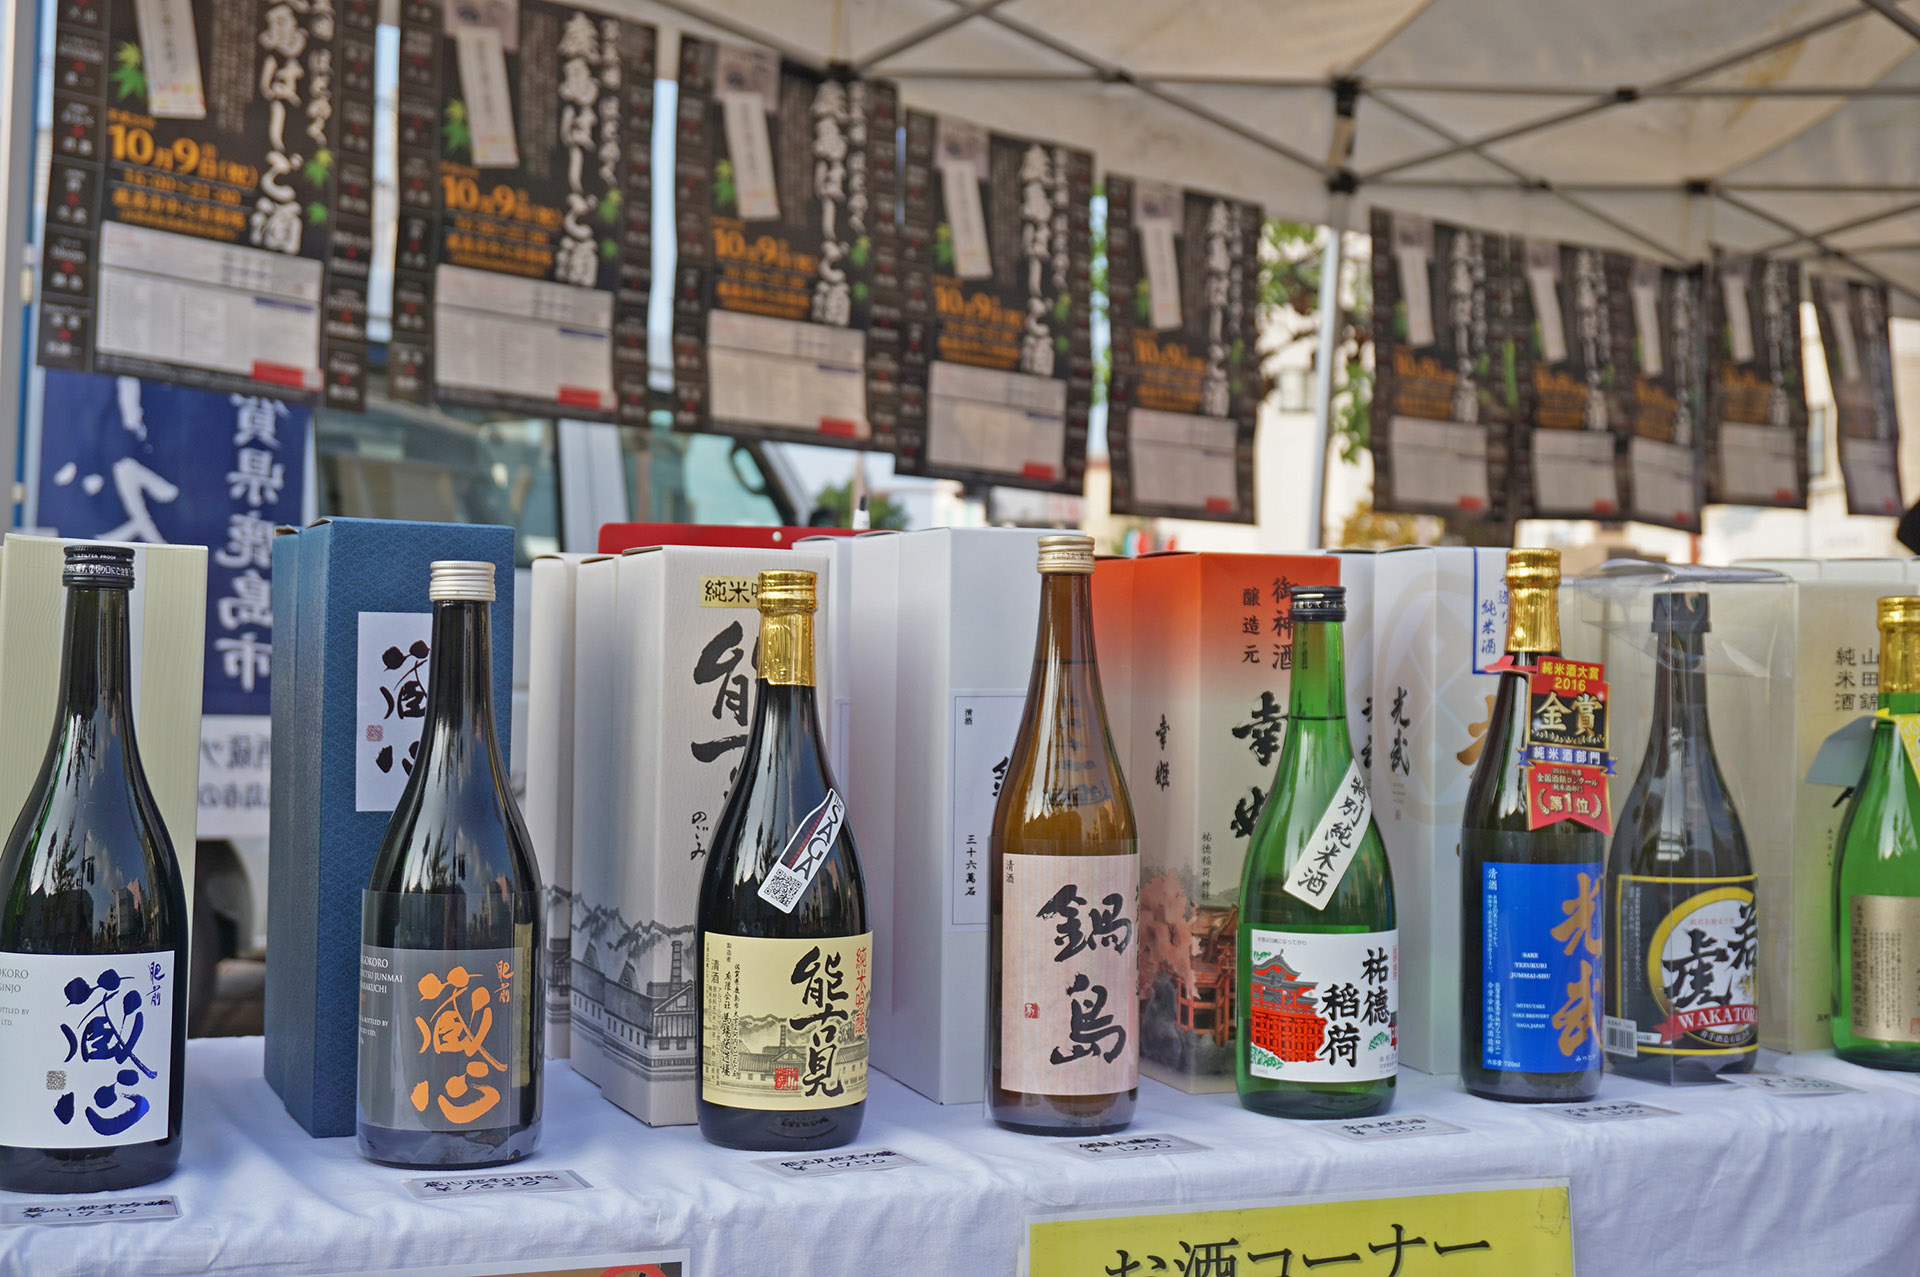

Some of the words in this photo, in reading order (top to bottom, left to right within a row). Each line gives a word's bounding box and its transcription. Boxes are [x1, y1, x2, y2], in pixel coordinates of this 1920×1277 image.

[1481, 598, 1497, 655] 純米酒
[1541, 660, 1600, 681] 純米酒大賞
[1554, 677, 1587, 692] 2016
[1835, 647, 1856, 712] 純米酒
[1535, 690, 1604, 738] 金賞
[1533, 745, 1601, 766] 純米酒部門
[1549, 792, 1590, 815] 第1位
[792, 804, 842, 881] SAGA
[1297, 775, 1367, 897] 特別純米酒
[1006, 859, 1015, 884] 清酒
[1487, 867, 1498, 891] 清酒
[374, 971, 403, 983] JUNMAI
[1036, 884, 1133, 1066] 鍋島
[790, 945, 850, 1099] 能古見
[1320, 982, 1361, 1069] 稲荷
